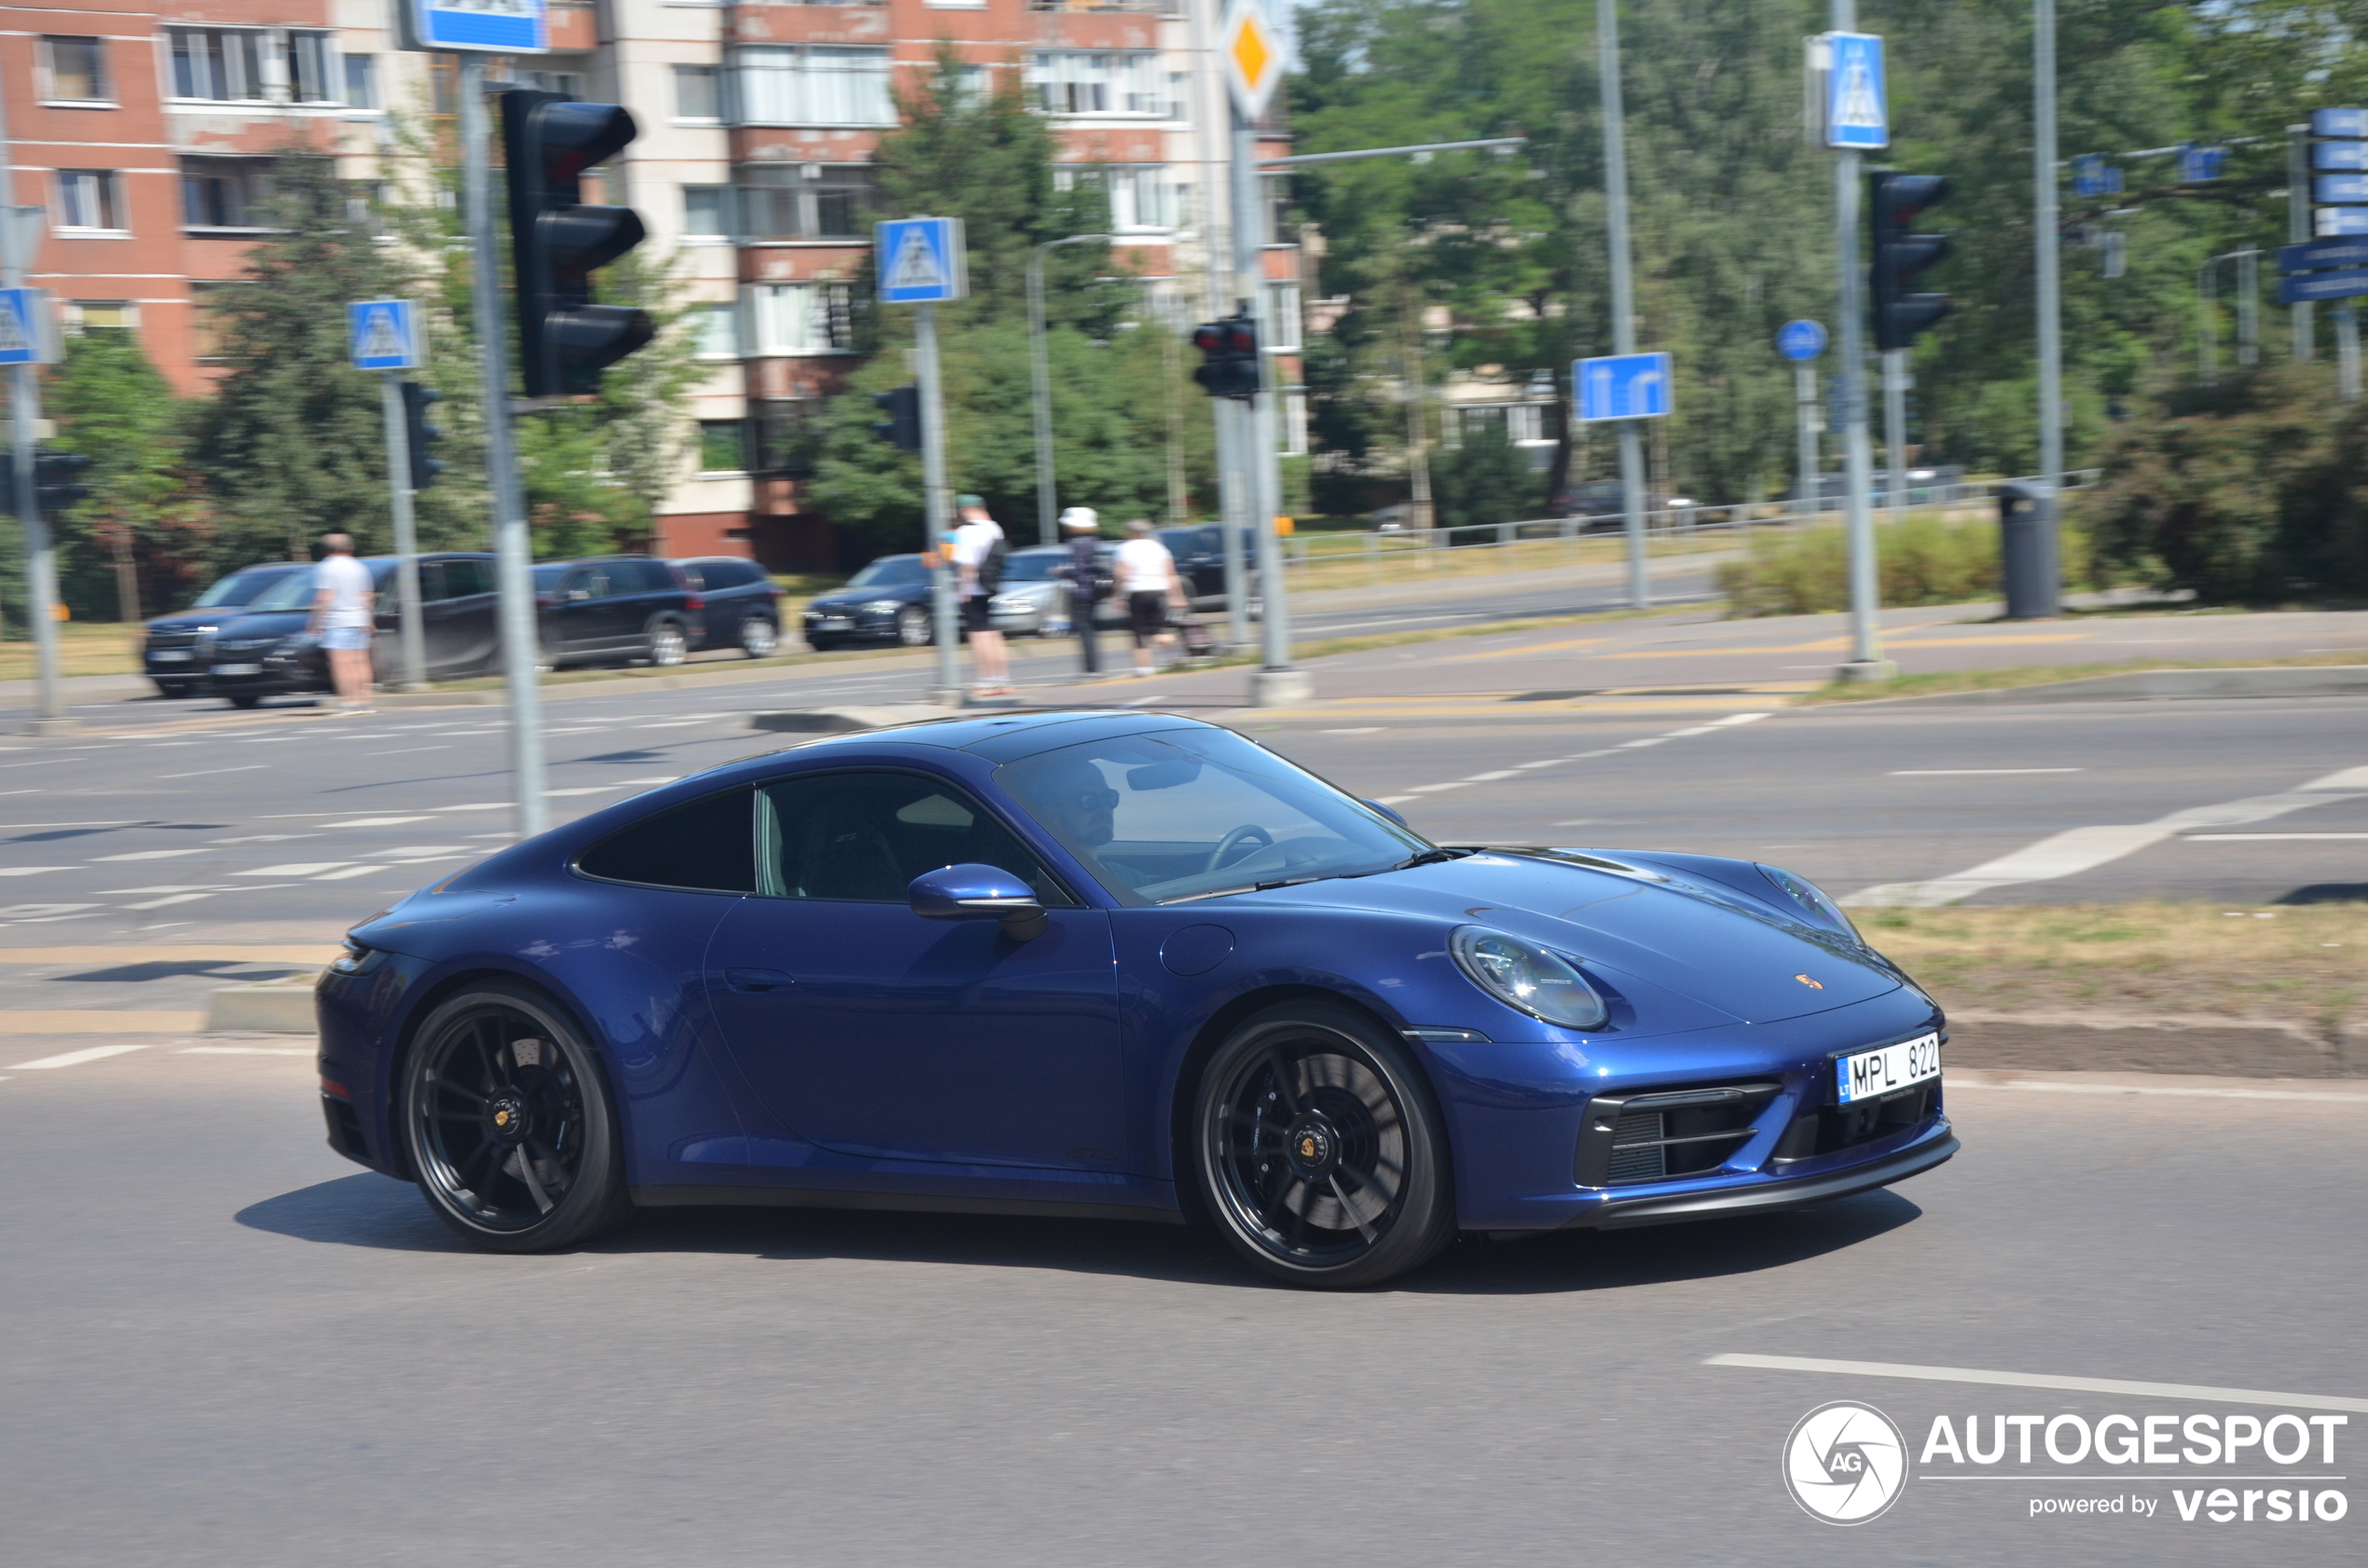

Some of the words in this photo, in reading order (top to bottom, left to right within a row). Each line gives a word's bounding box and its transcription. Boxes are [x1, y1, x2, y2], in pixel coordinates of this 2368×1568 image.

[835, 832, 857, 842] GTS
[1853, 1052, 1896, 1094] MPL
[1909, 1038, 1936, 1078] 822
[1839, 1084, 1850, 1096] LT
[1065, 1148, 1120, 1161] GTS
